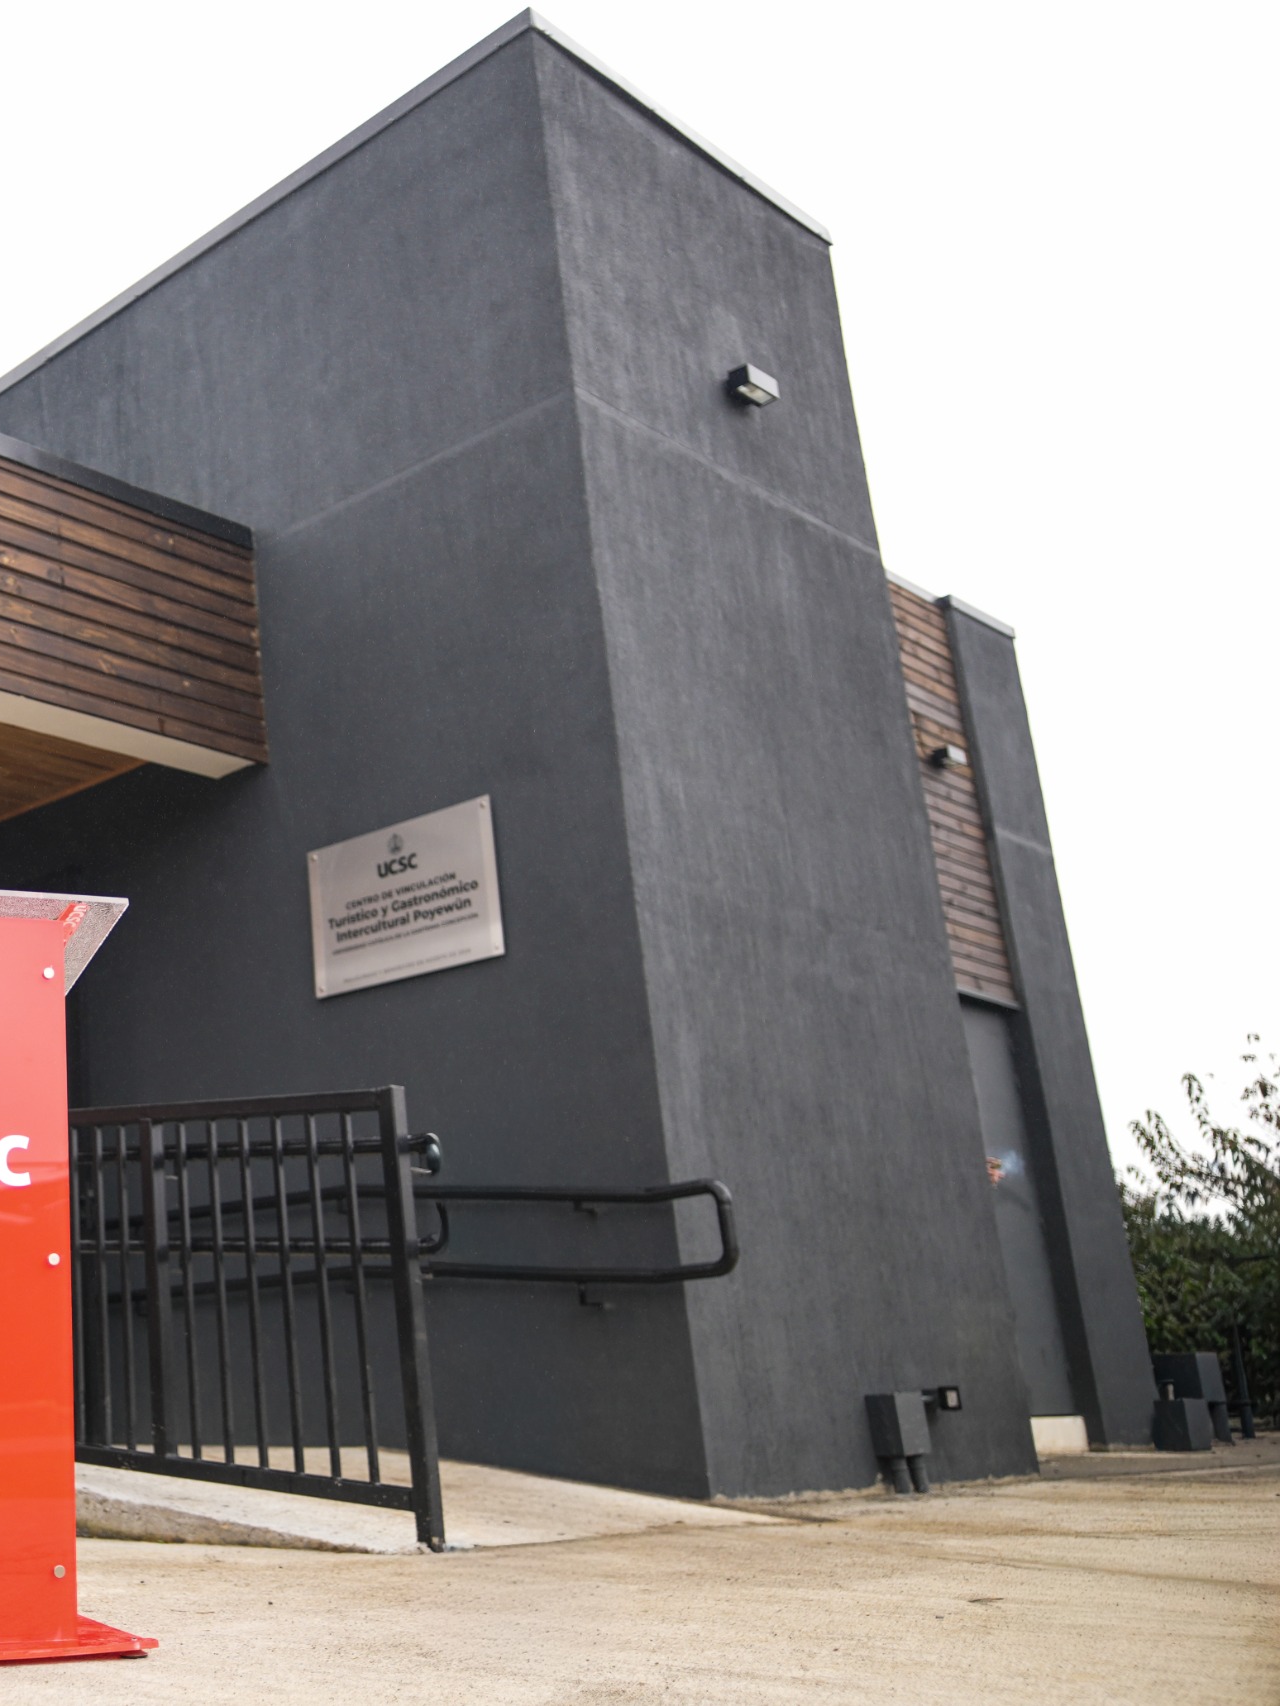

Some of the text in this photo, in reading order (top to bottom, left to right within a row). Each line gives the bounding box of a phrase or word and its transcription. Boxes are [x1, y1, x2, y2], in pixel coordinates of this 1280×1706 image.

[377, 852, 418, 878] UCSC
[345, 872, 457, 910] CENTRO DE VINCULACIÓN
[381, 904, 389, 919] y
[336, 914, 410, 943] Intercultural
